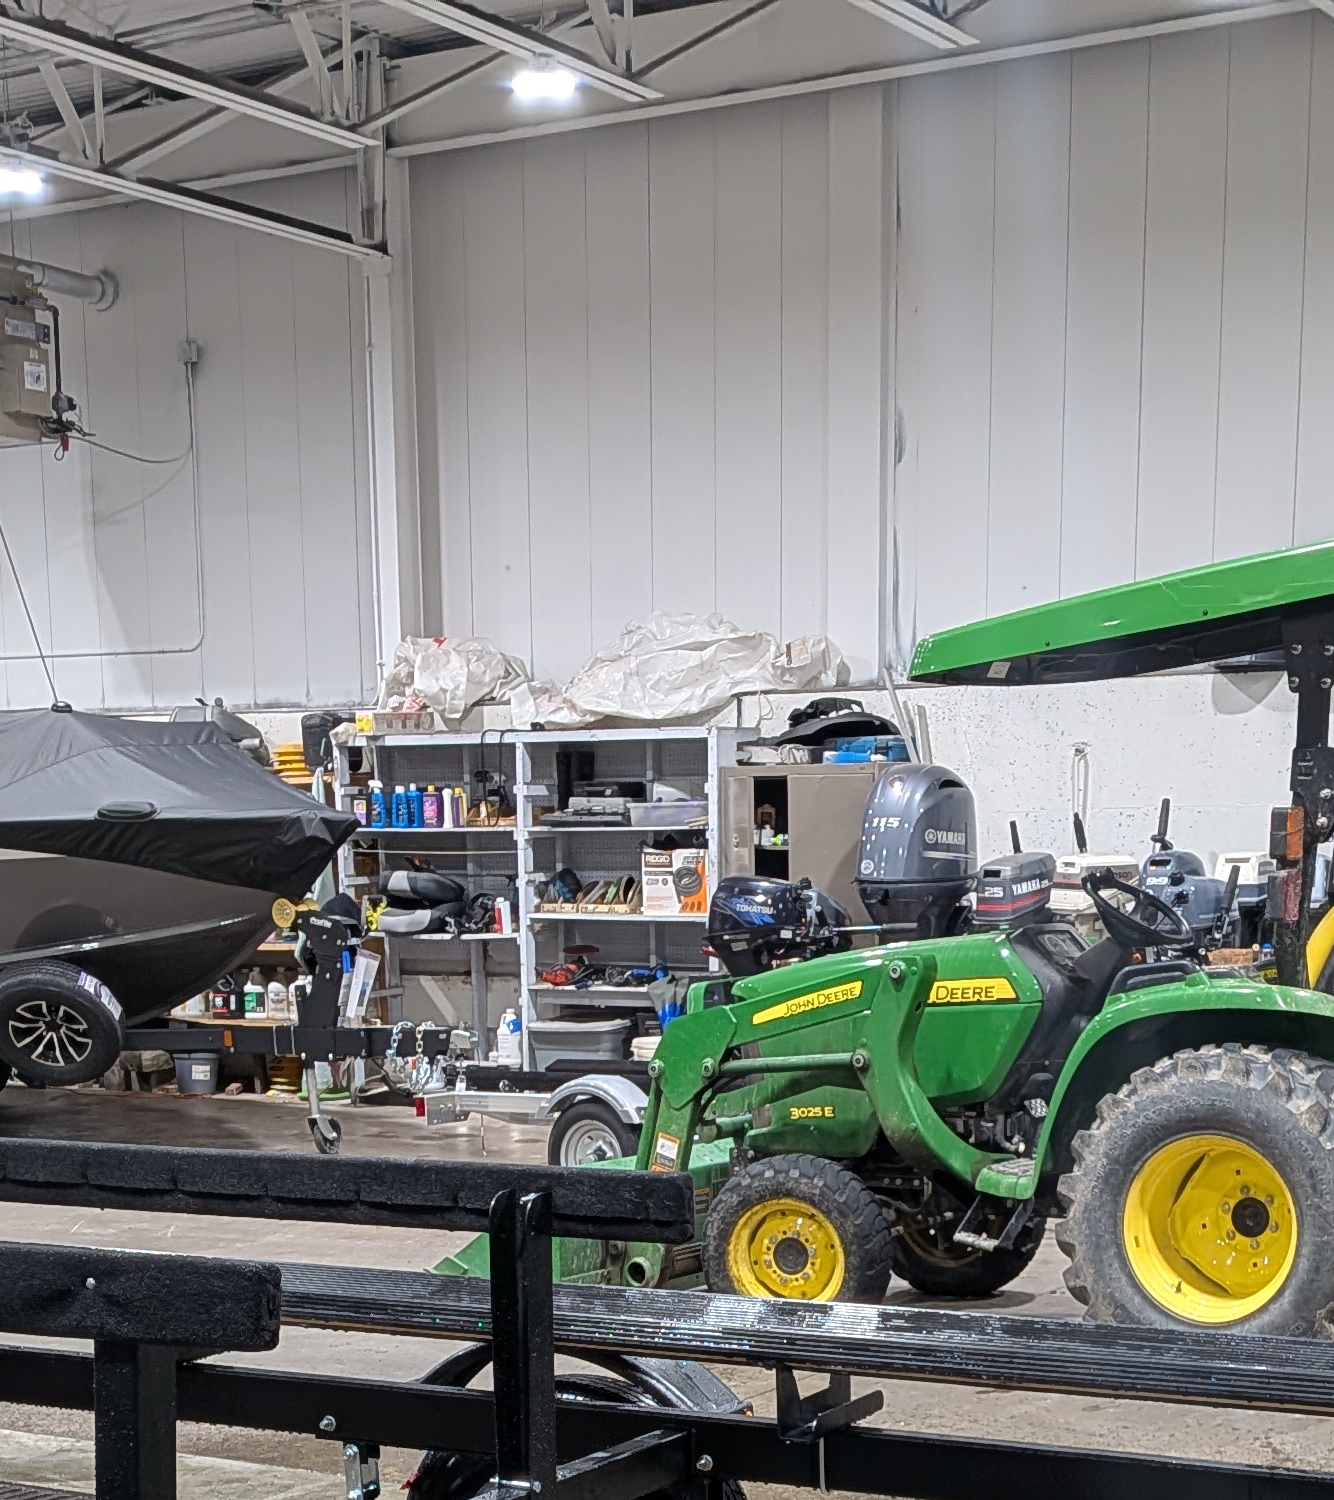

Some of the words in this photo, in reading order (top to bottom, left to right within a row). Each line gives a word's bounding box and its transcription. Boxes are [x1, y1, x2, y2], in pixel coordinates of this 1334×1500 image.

[871, 816, 902, 828] 115
[937, 830, 966, 846] YAMAH
[984, 886, 1004, 898] 25
[1011, 878, 1041, 896] YAMAHA
[736, 903, 773, 915] TOHATSU
[783, 997, 815, 1016] JOHN
[816, 986, 858, 1006] DEERE
[935, 985, 996, 1001] DEERE
